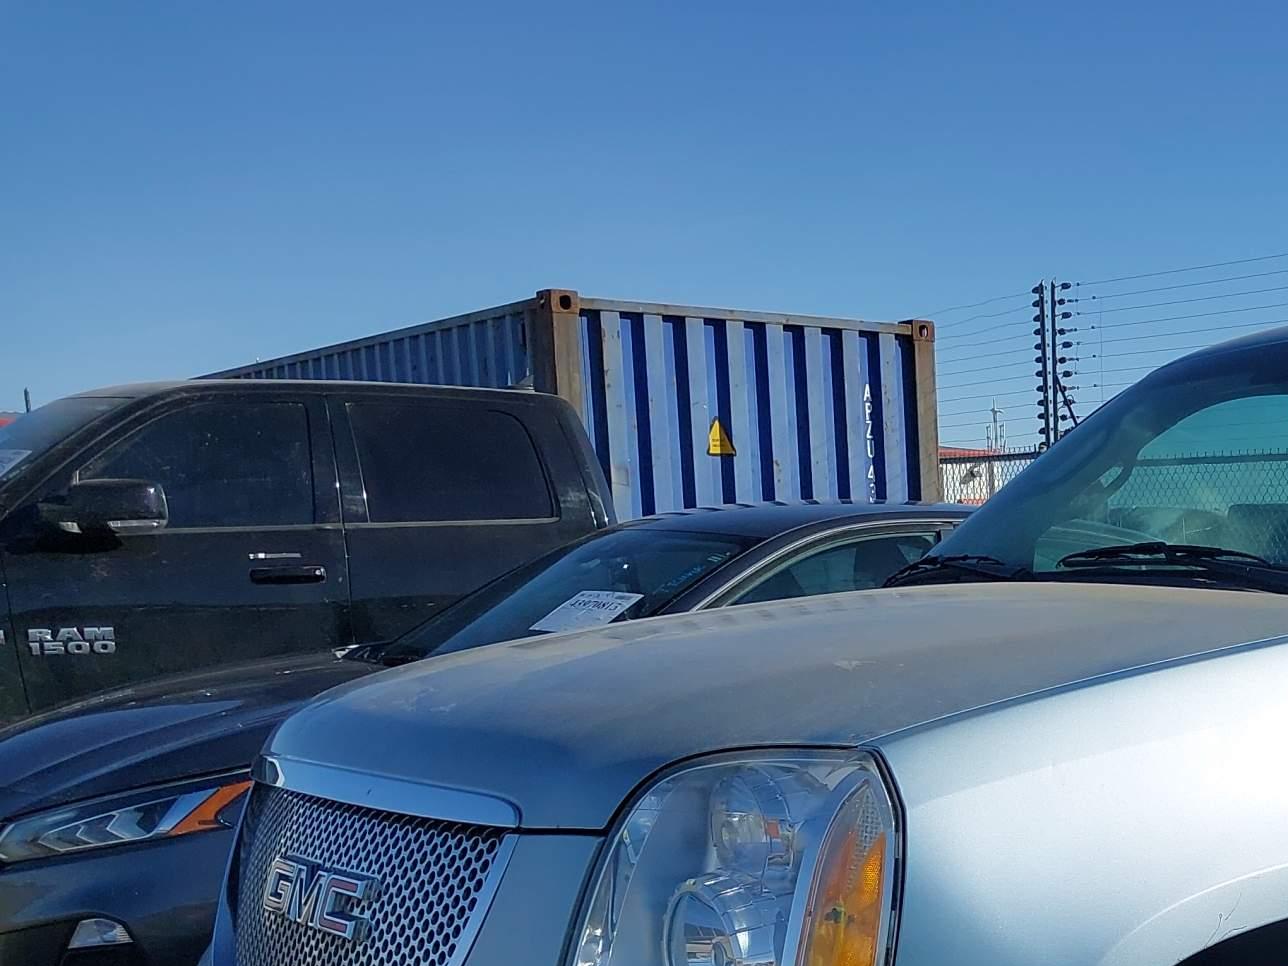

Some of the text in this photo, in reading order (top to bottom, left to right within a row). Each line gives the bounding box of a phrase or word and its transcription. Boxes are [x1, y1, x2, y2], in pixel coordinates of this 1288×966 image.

[27, 626, 115, 642] RAM
[29, 641, 116, 655] 1500
[263, 855, 368, 941] GMC
